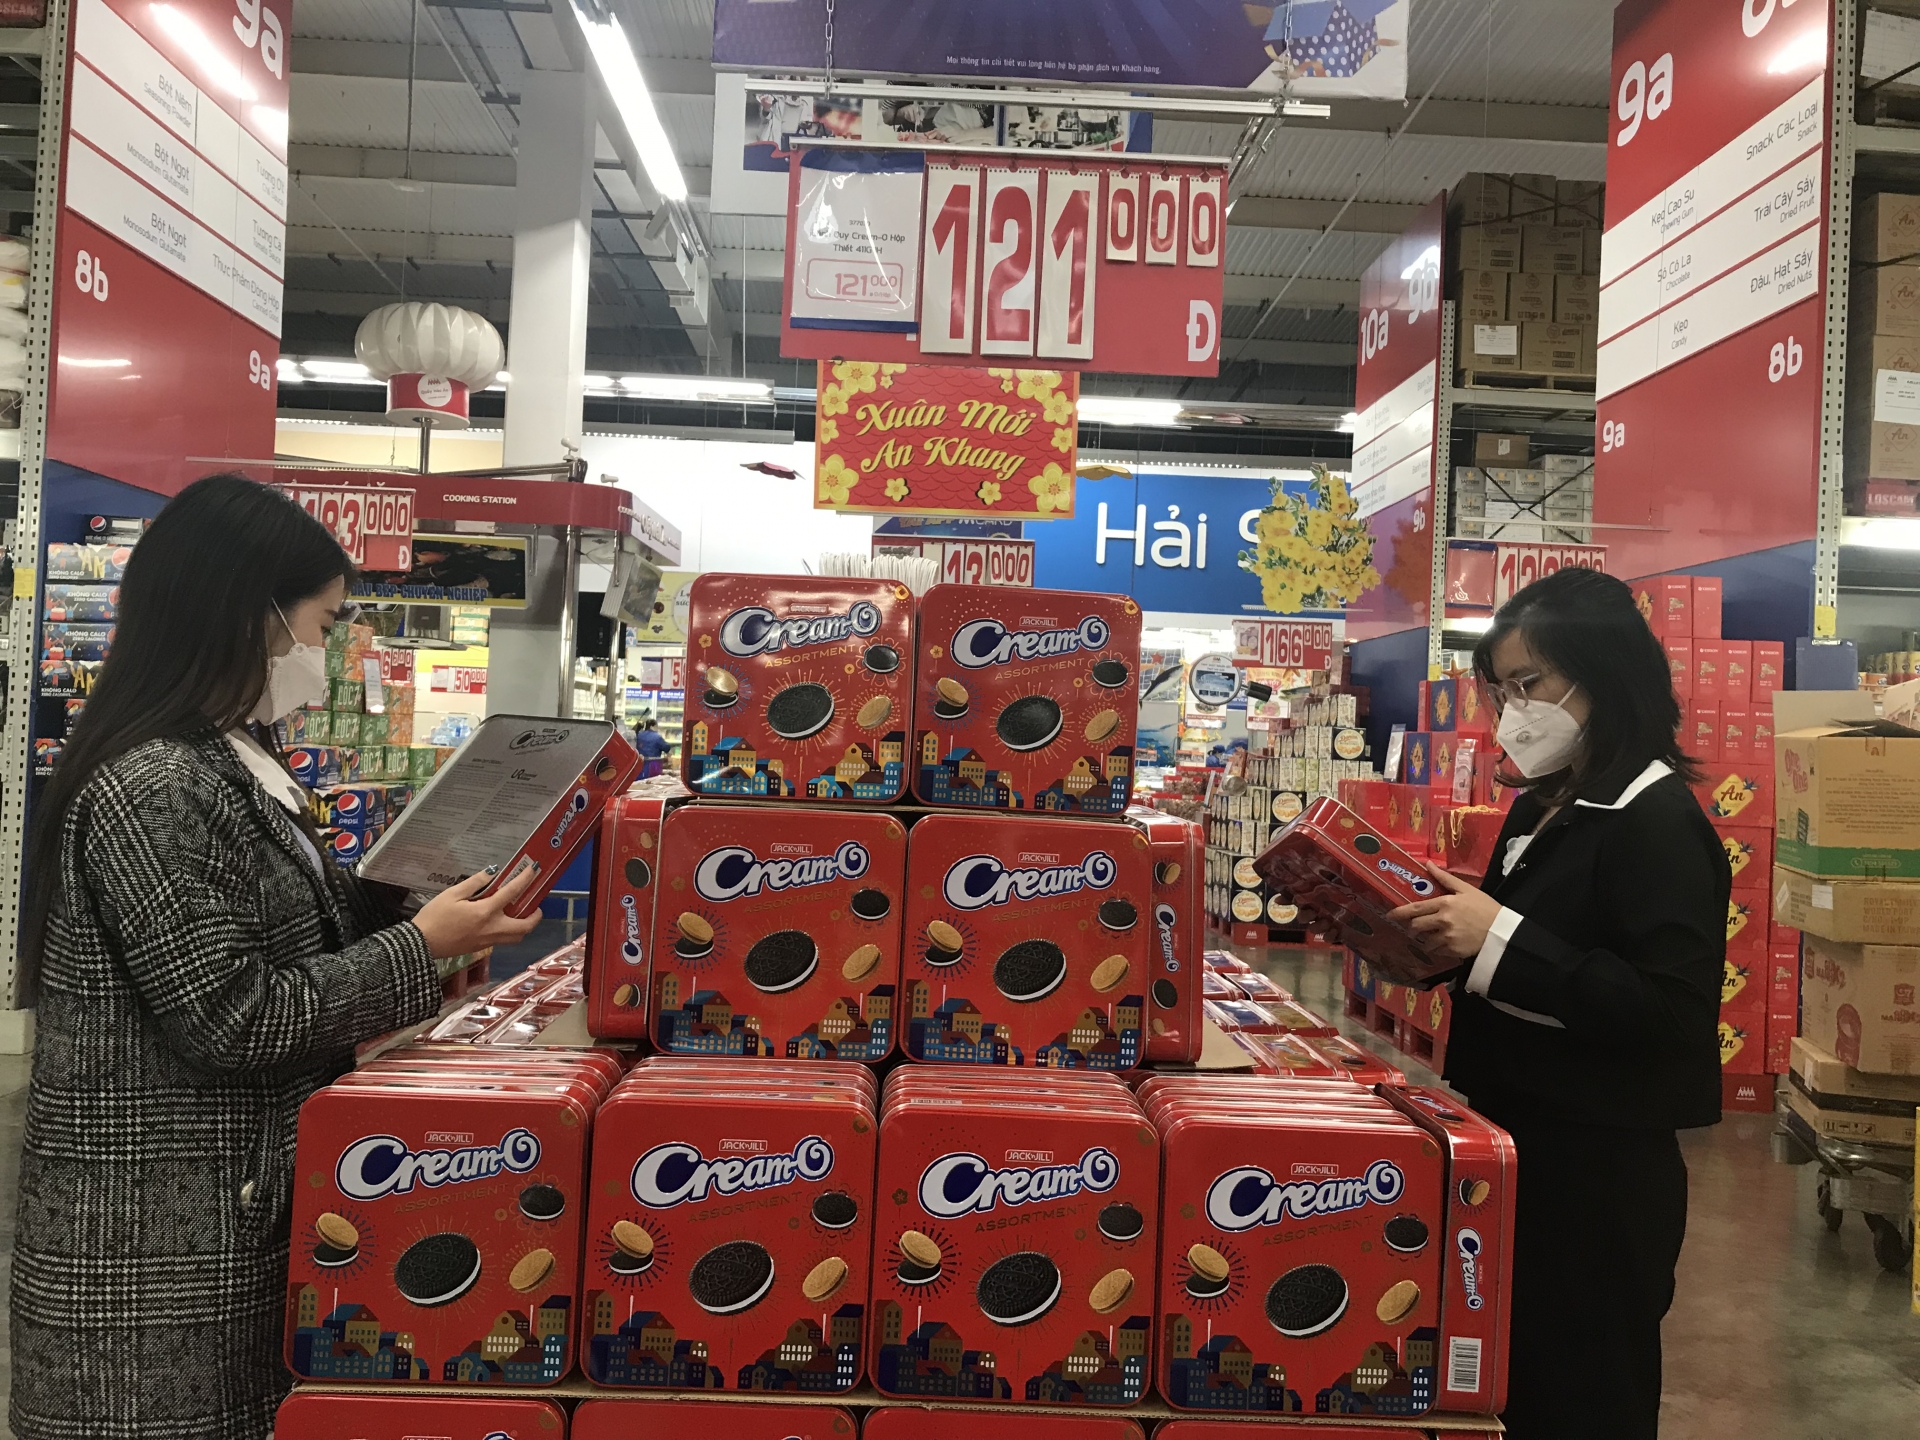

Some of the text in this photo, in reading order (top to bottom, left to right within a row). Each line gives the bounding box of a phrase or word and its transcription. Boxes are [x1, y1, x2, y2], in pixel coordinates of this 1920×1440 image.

[233, 0, 283, 80] 9a
[158, 75, 171, 91] Bột
[1617, 53, 1673, 147] 9a
[1746, 99, 1818, 161] Snack Các Loại
[1797, 120, 1818, 142] Snack
[127, 142, 189, 196] Monosodium Glutamate
[155, 142, 189, 182] Bột Ngọt
[1651, 189, 1695, 227] Kẹo Cao Su
[1773, 189, 1793, 211] Cây
[1779, 194, 1815, 224] Dried Fruit
[150, 212, 187, 249] Bột Ngọt
[1659, 206, 1694, 235] Chewing Gum
[122, 214, 186, 264] Monosodium Glutamate
[890, 231, 906, 244] Hộp
[75, 249, 108, 302] 8b
[932, 184, 1091, 346] 121
[1681, 253, 1691, 269] La
[1773, 259, 1792, 281] Hạt
[1407, 258, 1439, 325] 9b
[1665, 270, 1691, 291] Chocolate
[1777, 270, 1813, 295] Dried Nuts
[1186, 299, 1217, 362] Đ
[1361, 308, 1389, 366] 10a
[1671, 334, 1688, 350] Candy
[1673, 319, 1688, 335] Kẹo
[249, 349, 271, 391] 9a
[1768, 335, 1803, 383] 8b
[855, 398, 1036, 437] Xuân Mới
[1602, 419, 1625, 453] 9a
[860, 436, 1026, 481] An Khang
[443, 494, 517, 505] COOKING STATION
[1095, 501, 1208, 570] Hải
[1412, 506, 1426, 532] 9b
[398, 545, 410, 569] Đ
[764, 644, 855, 670] ASSORTMENT
[1265, 628, 1302, 664] 166
[994, 657, 1086, 682] ASSORTMENT
[1720, 784, 1746, 802] An
[338, 818, 358, 826] pepsi
[743, 886, 844, 914] ASSORTMENT
[991, 897, 1090, 923] ASSORTMENT
[393, 1182, 509, 1215] ASSORTMENT
[686, 1190, 803, 1224] ASSORTMENT
[973, 1201, 1089, 1234] ASSORTMENT
[1261, 1214, 1375, 1247] ASSORTMENT
